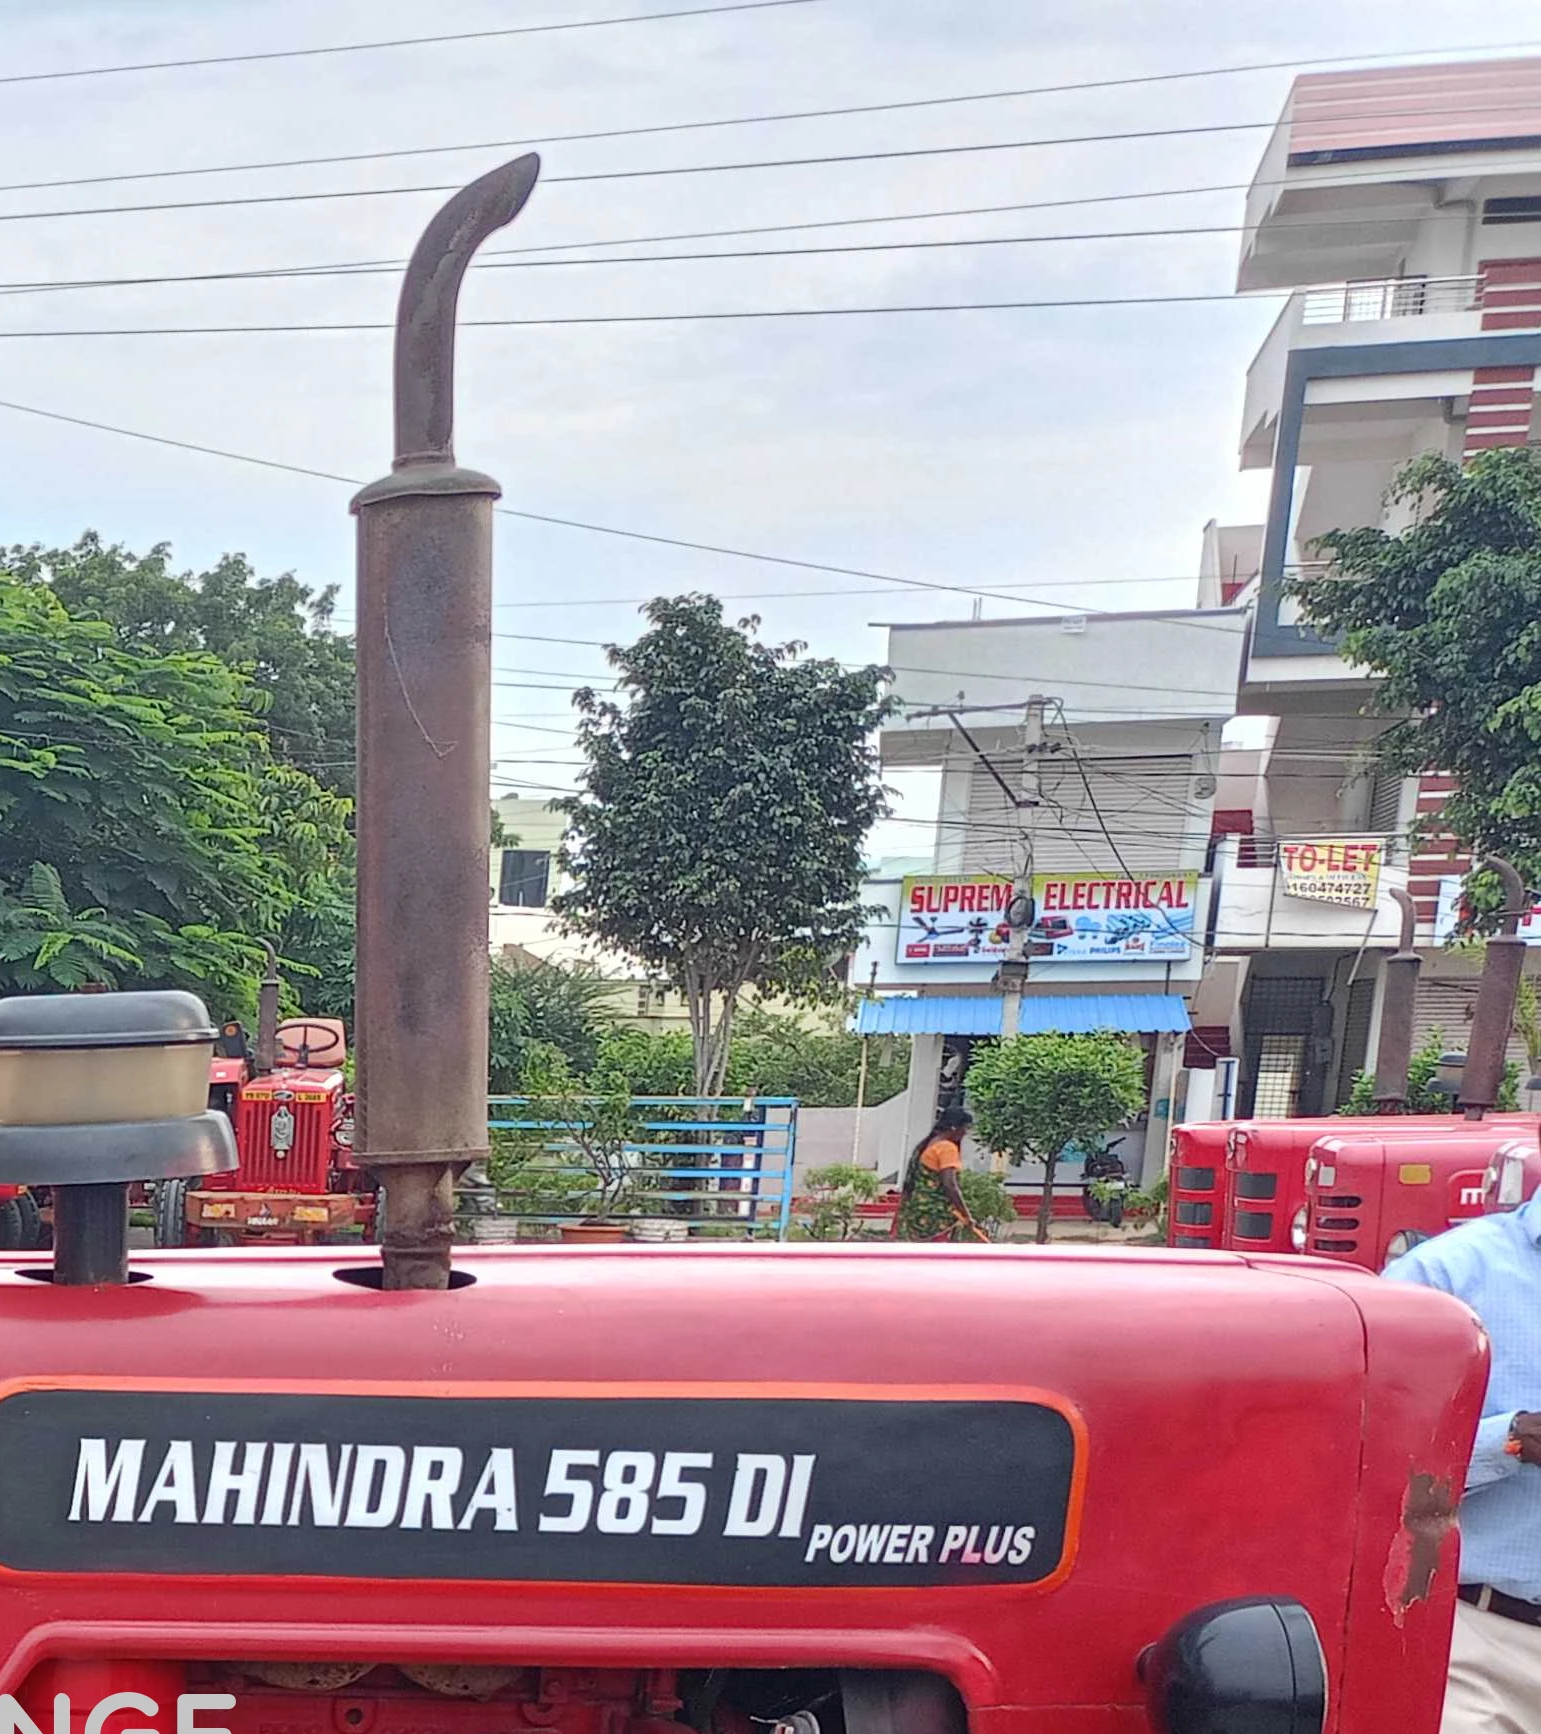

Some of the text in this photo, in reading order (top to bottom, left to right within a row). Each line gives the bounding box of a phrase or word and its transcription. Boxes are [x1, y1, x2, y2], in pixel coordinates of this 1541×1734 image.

[1283, 844, 1378, 872] TO-LET
[910, 879, 1189, 913] SUPREM ELECTRICAL
[67, 1438, 816, 1540] MAHINDRA 585 DI
[804, 1523, 1035, 1567] POWER PLUS
